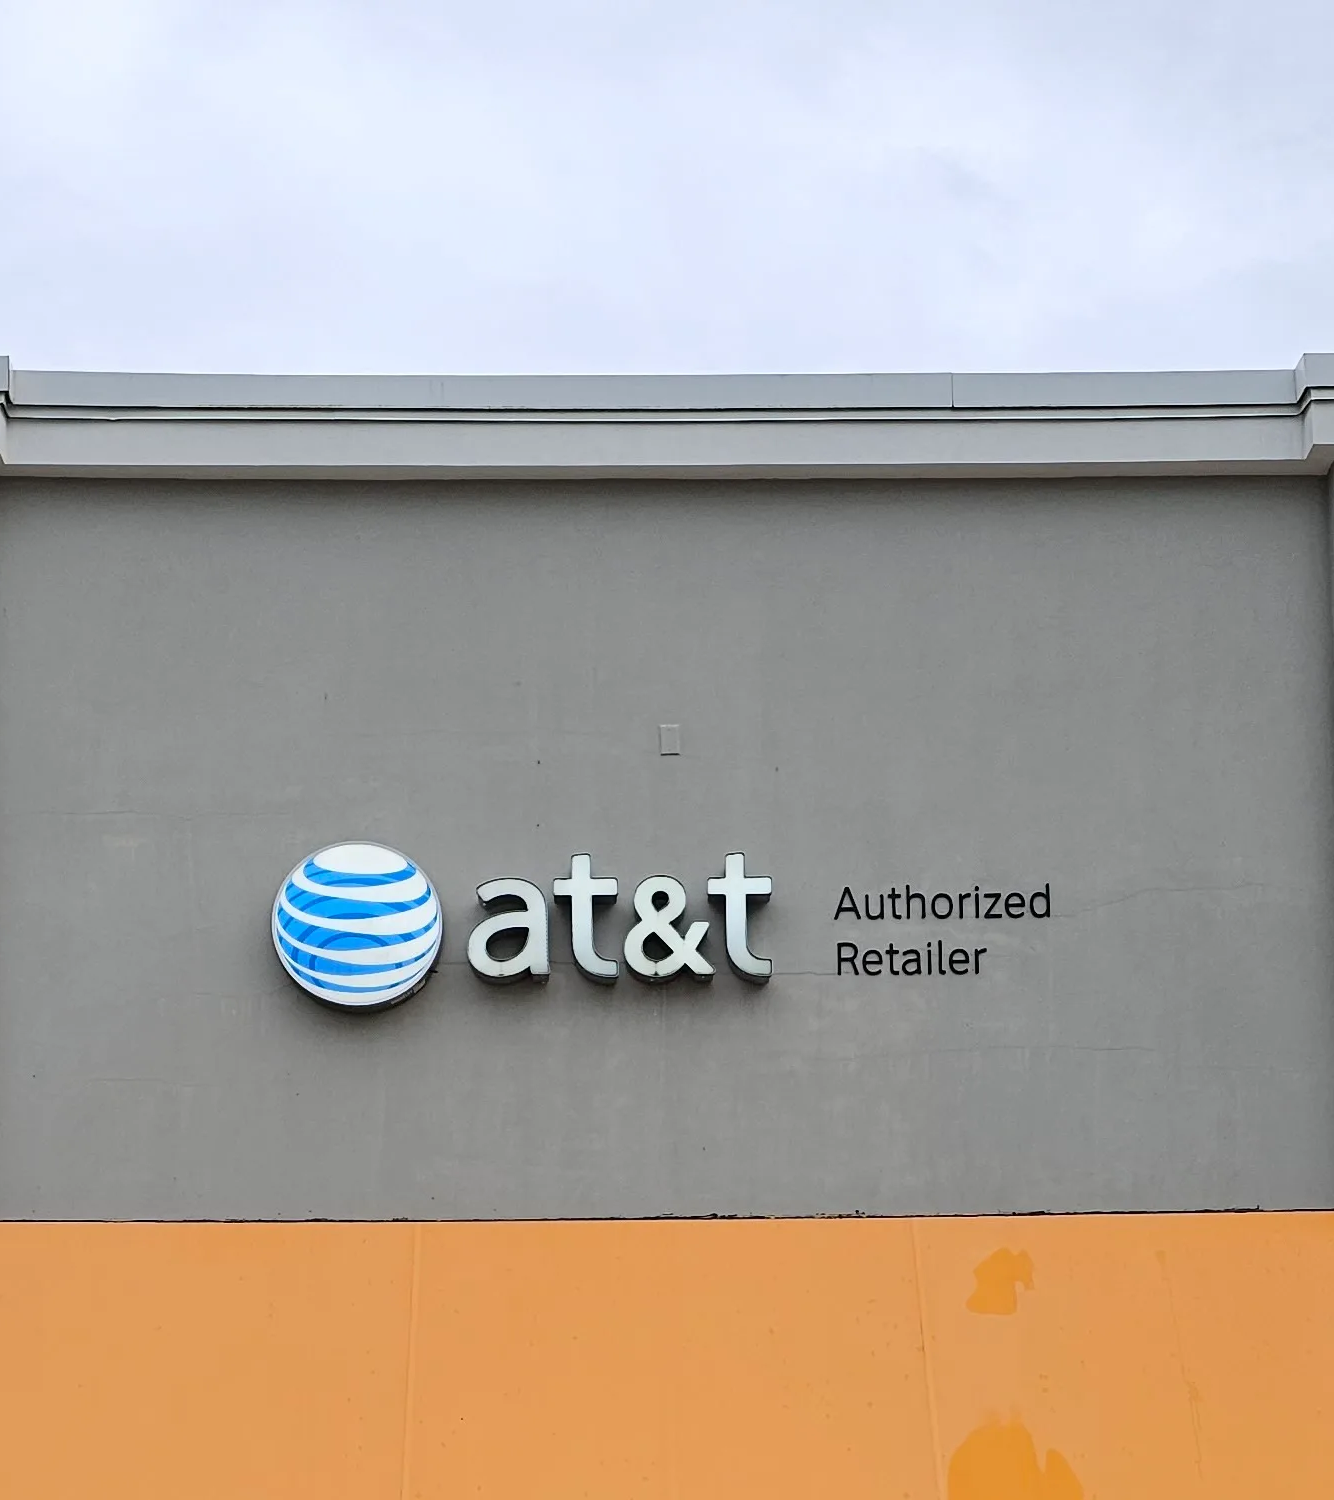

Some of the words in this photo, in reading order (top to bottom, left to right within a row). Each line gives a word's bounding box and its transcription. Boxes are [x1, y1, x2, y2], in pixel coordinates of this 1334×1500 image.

[465, 852, 774, 984] at&t
[832, 883, 1053, 921] Authorized
[835, 941, 988, 977] Retailer
